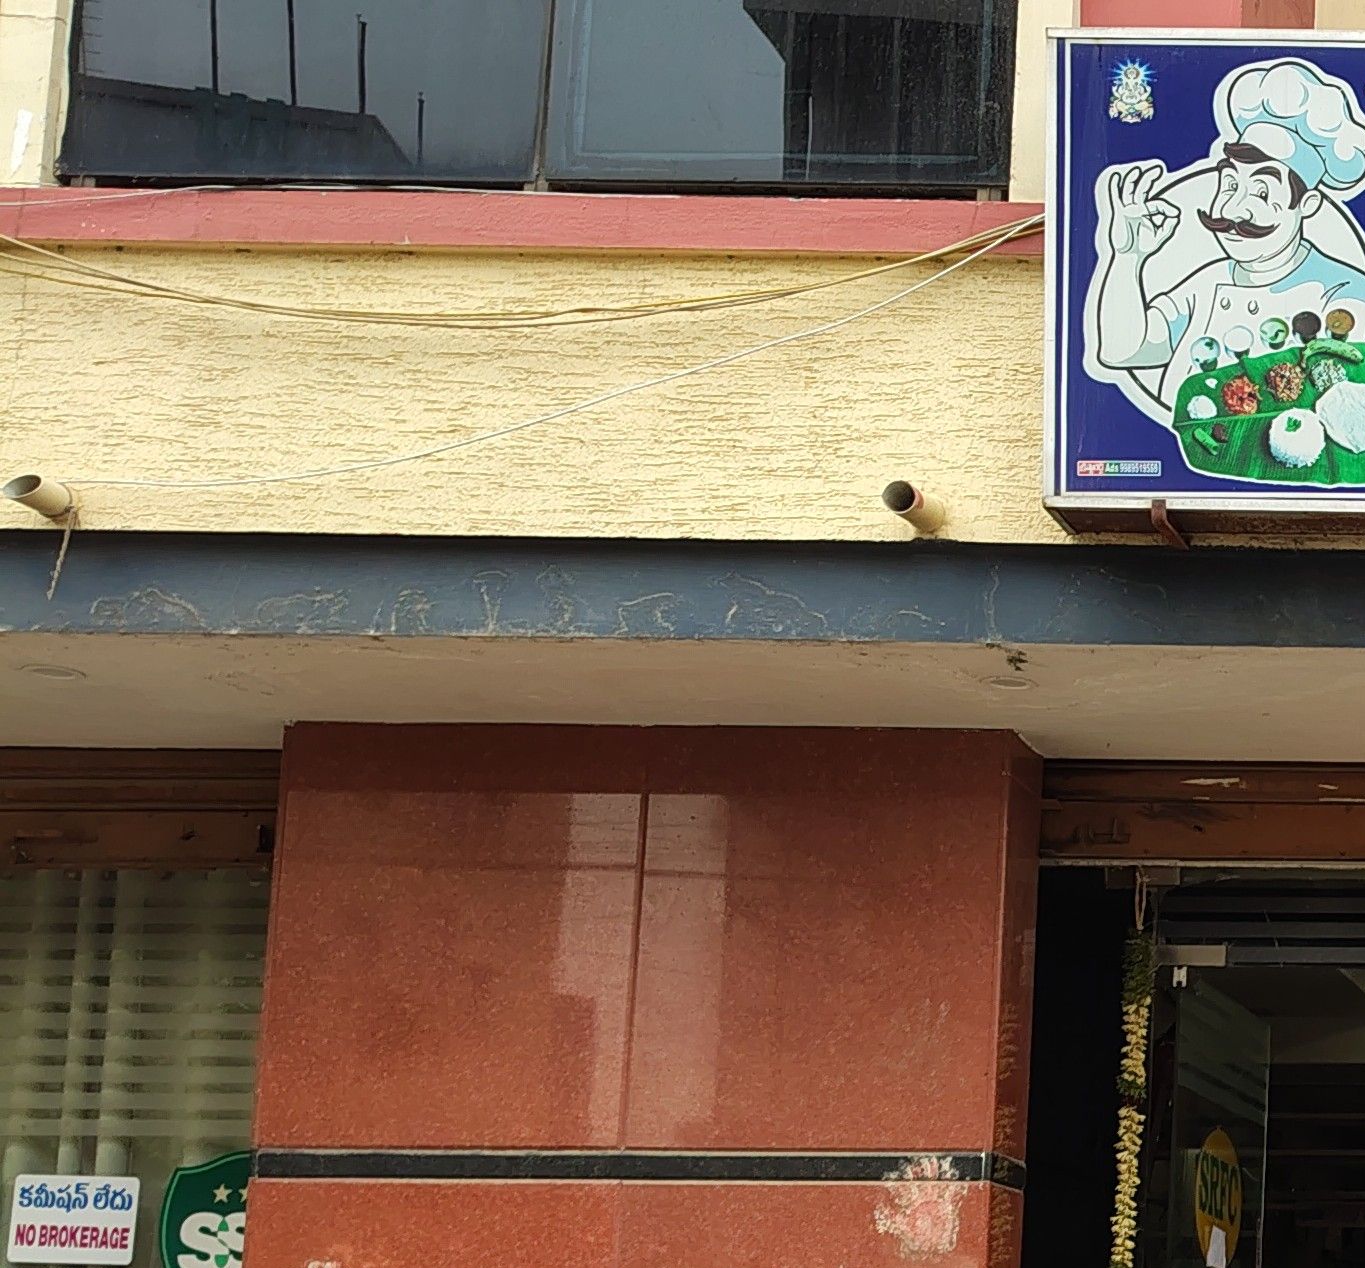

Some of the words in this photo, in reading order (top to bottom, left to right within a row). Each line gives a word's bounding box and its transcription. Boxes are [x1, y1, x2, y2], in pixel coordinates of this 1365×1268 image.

[18, 1182, 90, 1213] కమీషన్
[92, 1183, 133, 1212] లేదు
[14, 1223, 36, 1247] NO
[38, 1224, 130, 1250] BROKERAGE
